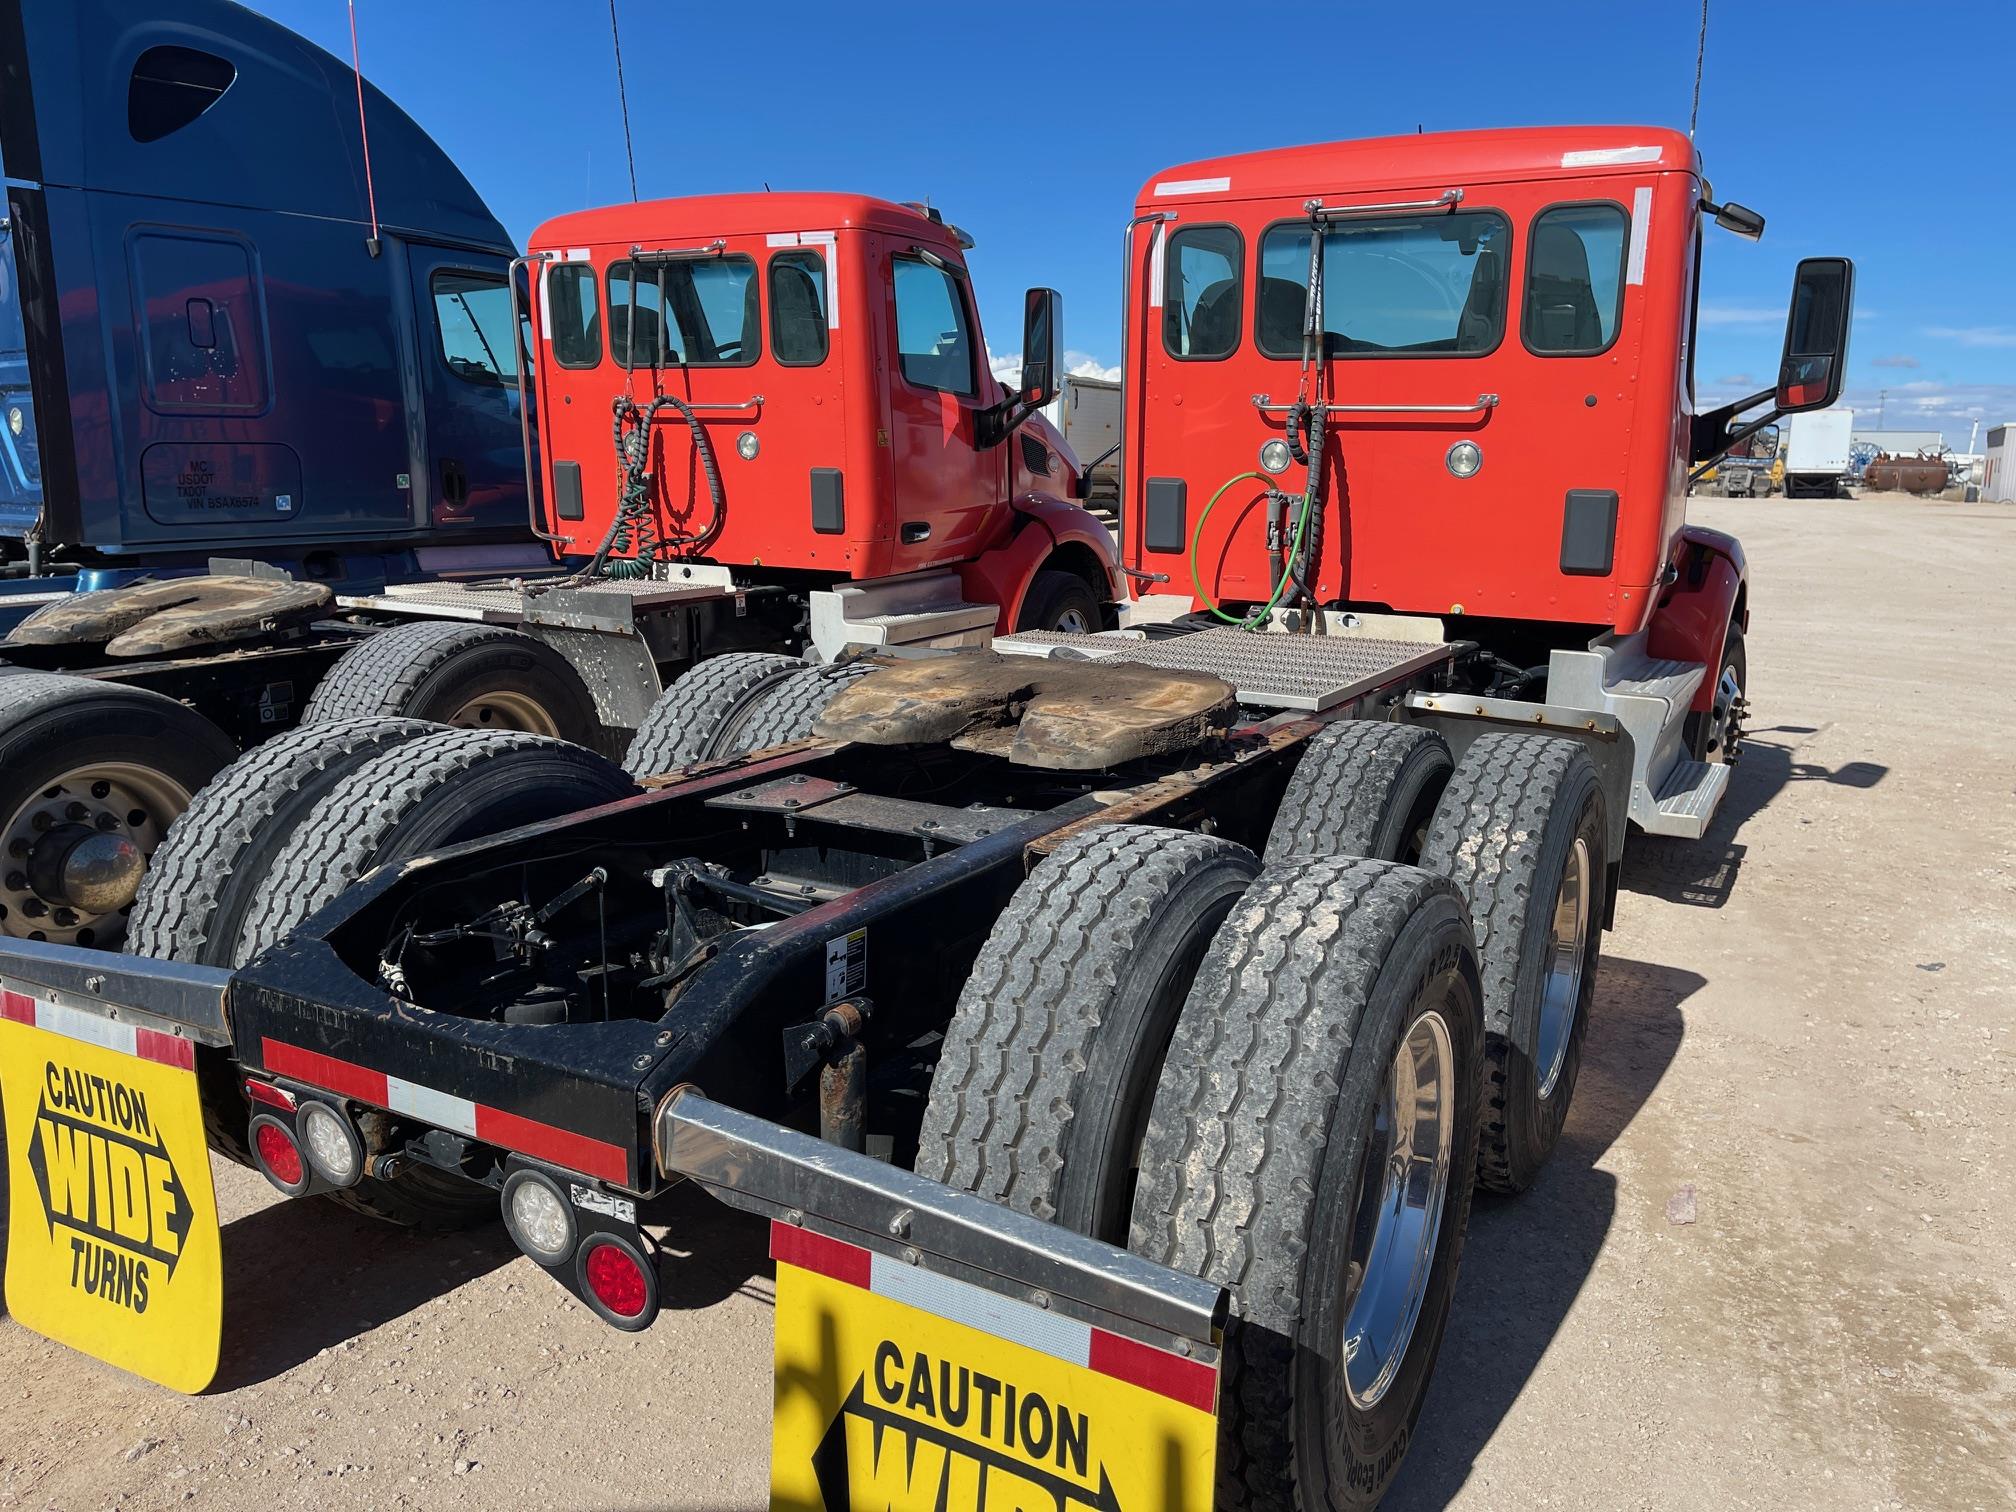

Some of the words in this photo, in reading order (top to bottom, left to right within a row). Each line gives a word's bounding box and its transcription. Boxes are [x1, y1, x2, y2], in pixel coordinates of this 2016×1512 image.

[177, 473, 215, 485] USDOT
[190, 460, 208, 472] MC
[177, 486, 207, 497] TXDOT
[187, 498, 204, 509] VIN
[46, 1060, 150, 1138] CAUTION
[38, 1116, 179, 1257] WIDE
[70, 1237, 149, 1314] TURNS
[874, 1339, 1088, 1478] CAUTION
